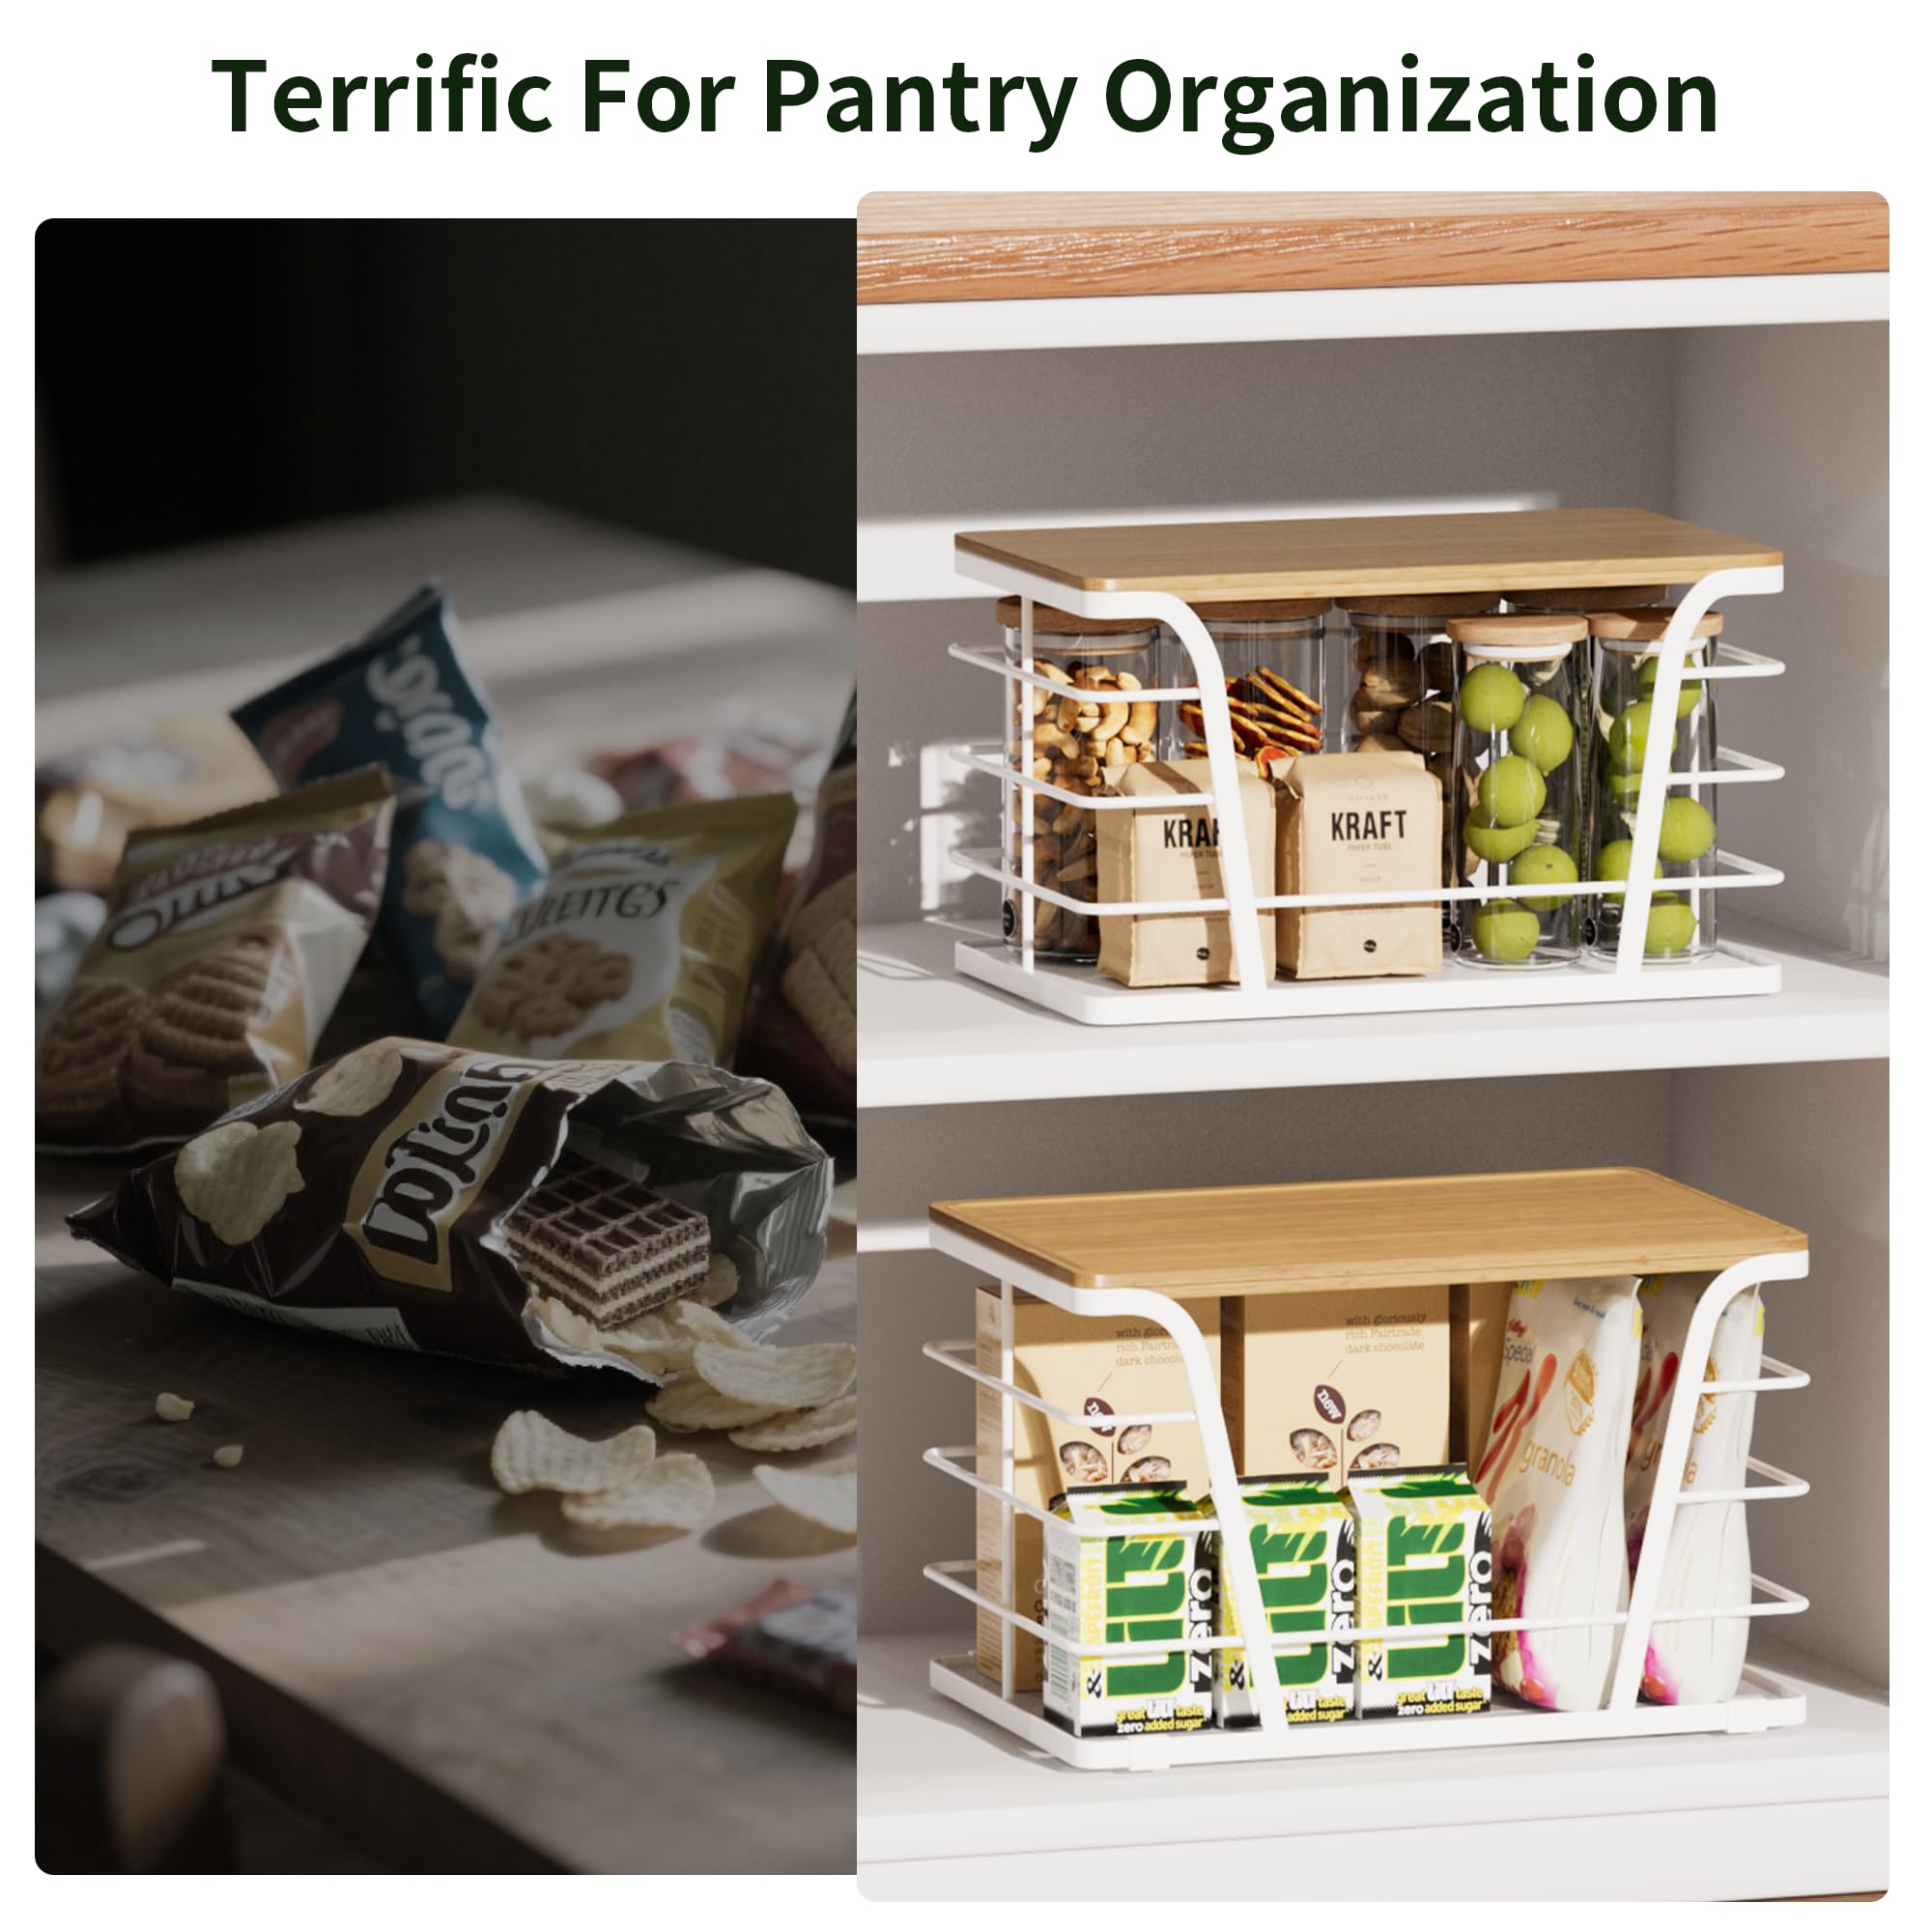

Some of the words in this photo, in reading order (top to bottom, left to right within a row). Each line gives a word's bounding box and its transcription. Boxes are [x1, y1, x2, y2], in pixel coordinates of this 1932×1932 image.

[1331, 810, 1406, 841] KRAFT
[1345, 1315, 1370, 1326] with
[1373, 1311, 1427, 1326] gloriously
[1116, 1327, 1141, 1338] with
[1345, 1343, 1371, 1353] dark
[1374, 1340, 1425, 1352] chocolate
[1317, 1388, 1343, 1420] new
[1518, 1439, 1577, 1488] granola
[1396, 1689, 1426, 1707] great
[1456, 1686, 1485, 1700] taste
[1116, 1705, 1146, 1724] great
[1176, 1703, 1205, 1718] taste
[1397, 1704, 1424, 1717] zero
[1424, 1699, 1455, 1715] added
[1117, 1721, 1144, 1734] zero
[1144, 1717, 1175, 1732] added
